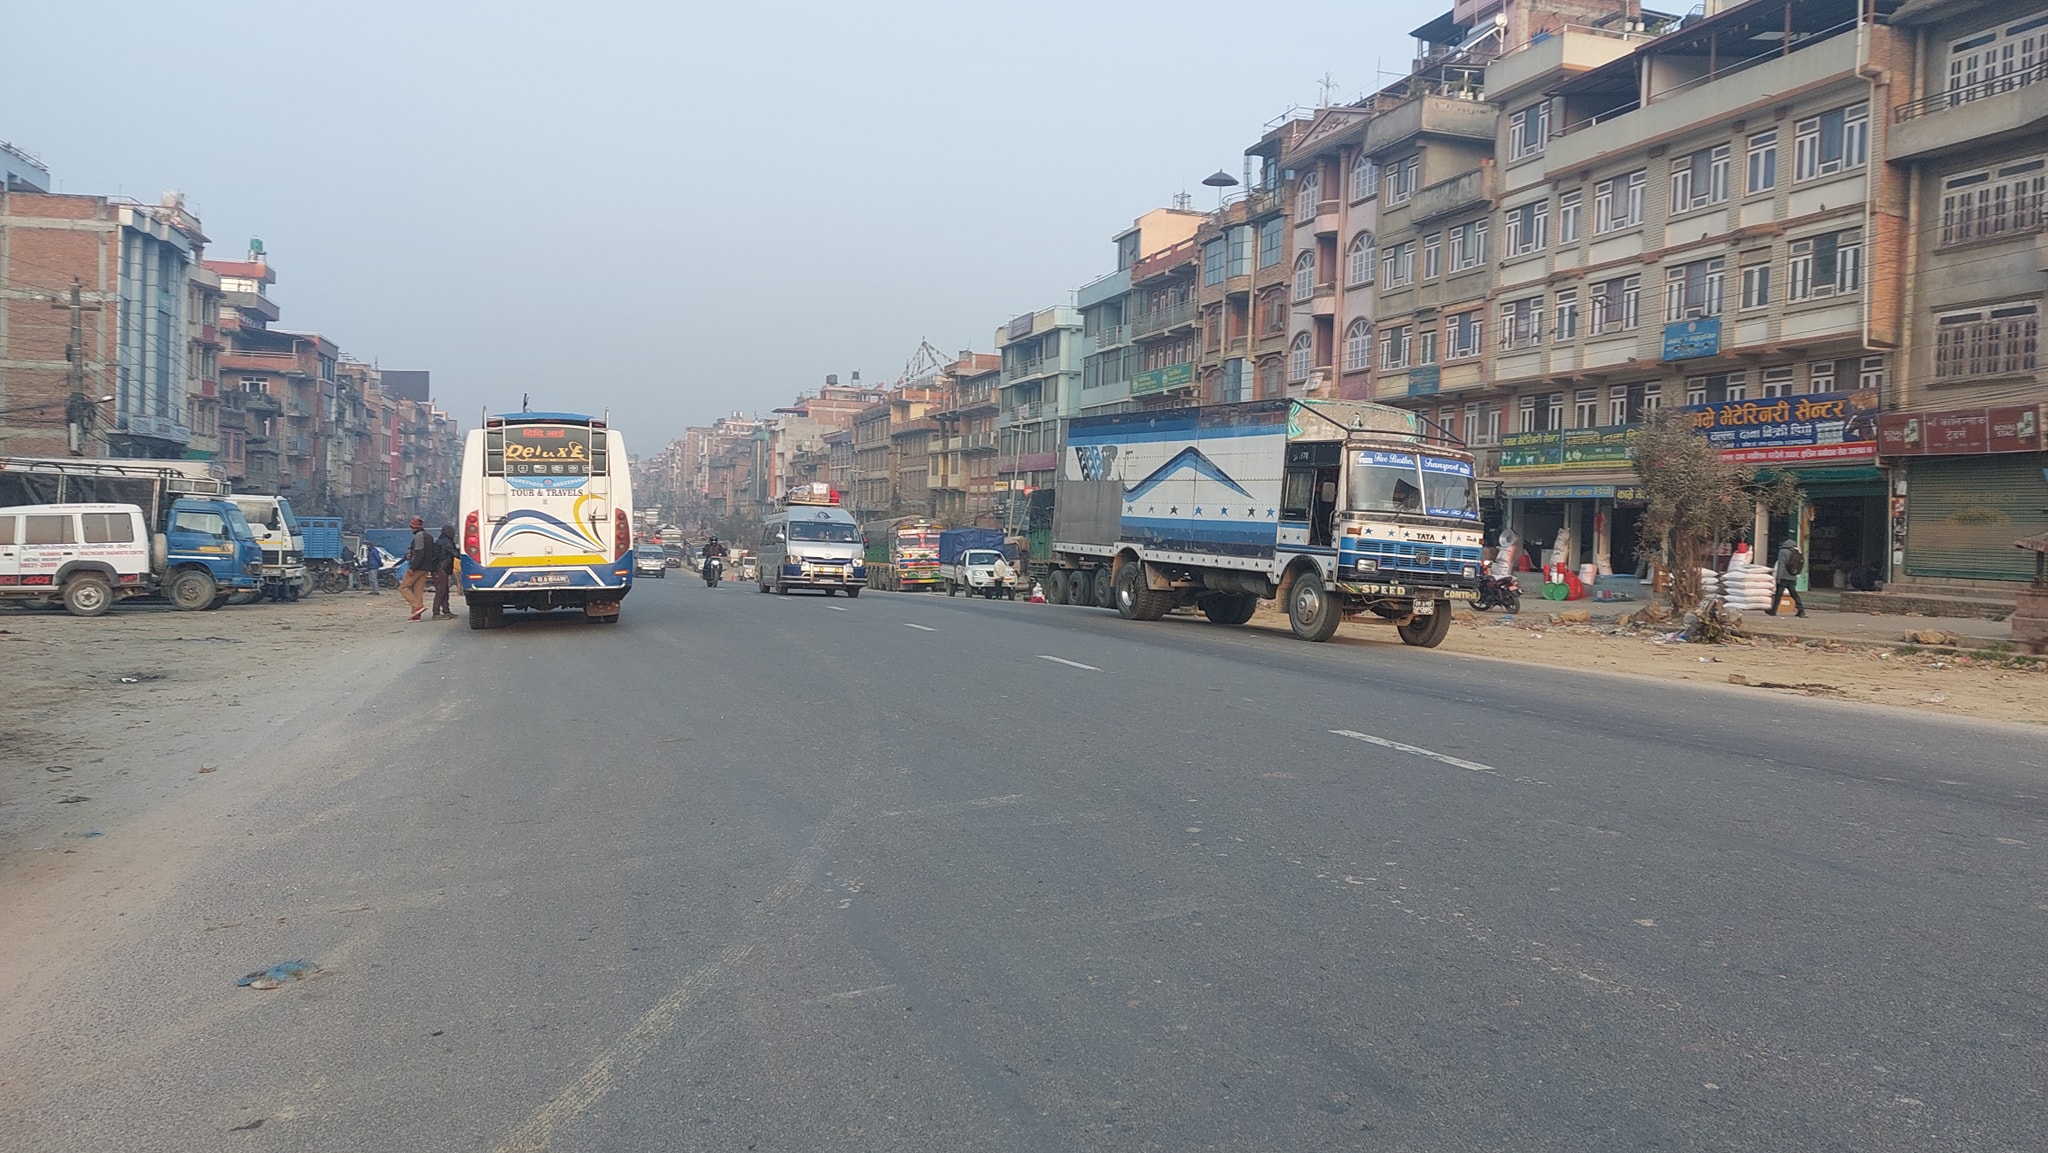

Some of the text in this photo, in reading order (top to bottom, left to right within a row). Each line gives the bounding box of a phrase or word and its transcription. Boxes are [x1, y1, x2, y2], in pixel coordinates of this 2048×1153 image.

[1794, 397, 1848, 421] सेन्टर
[511, 489, 535, 497] TOUR
[1362, 585, 1406, 595] SPEED
